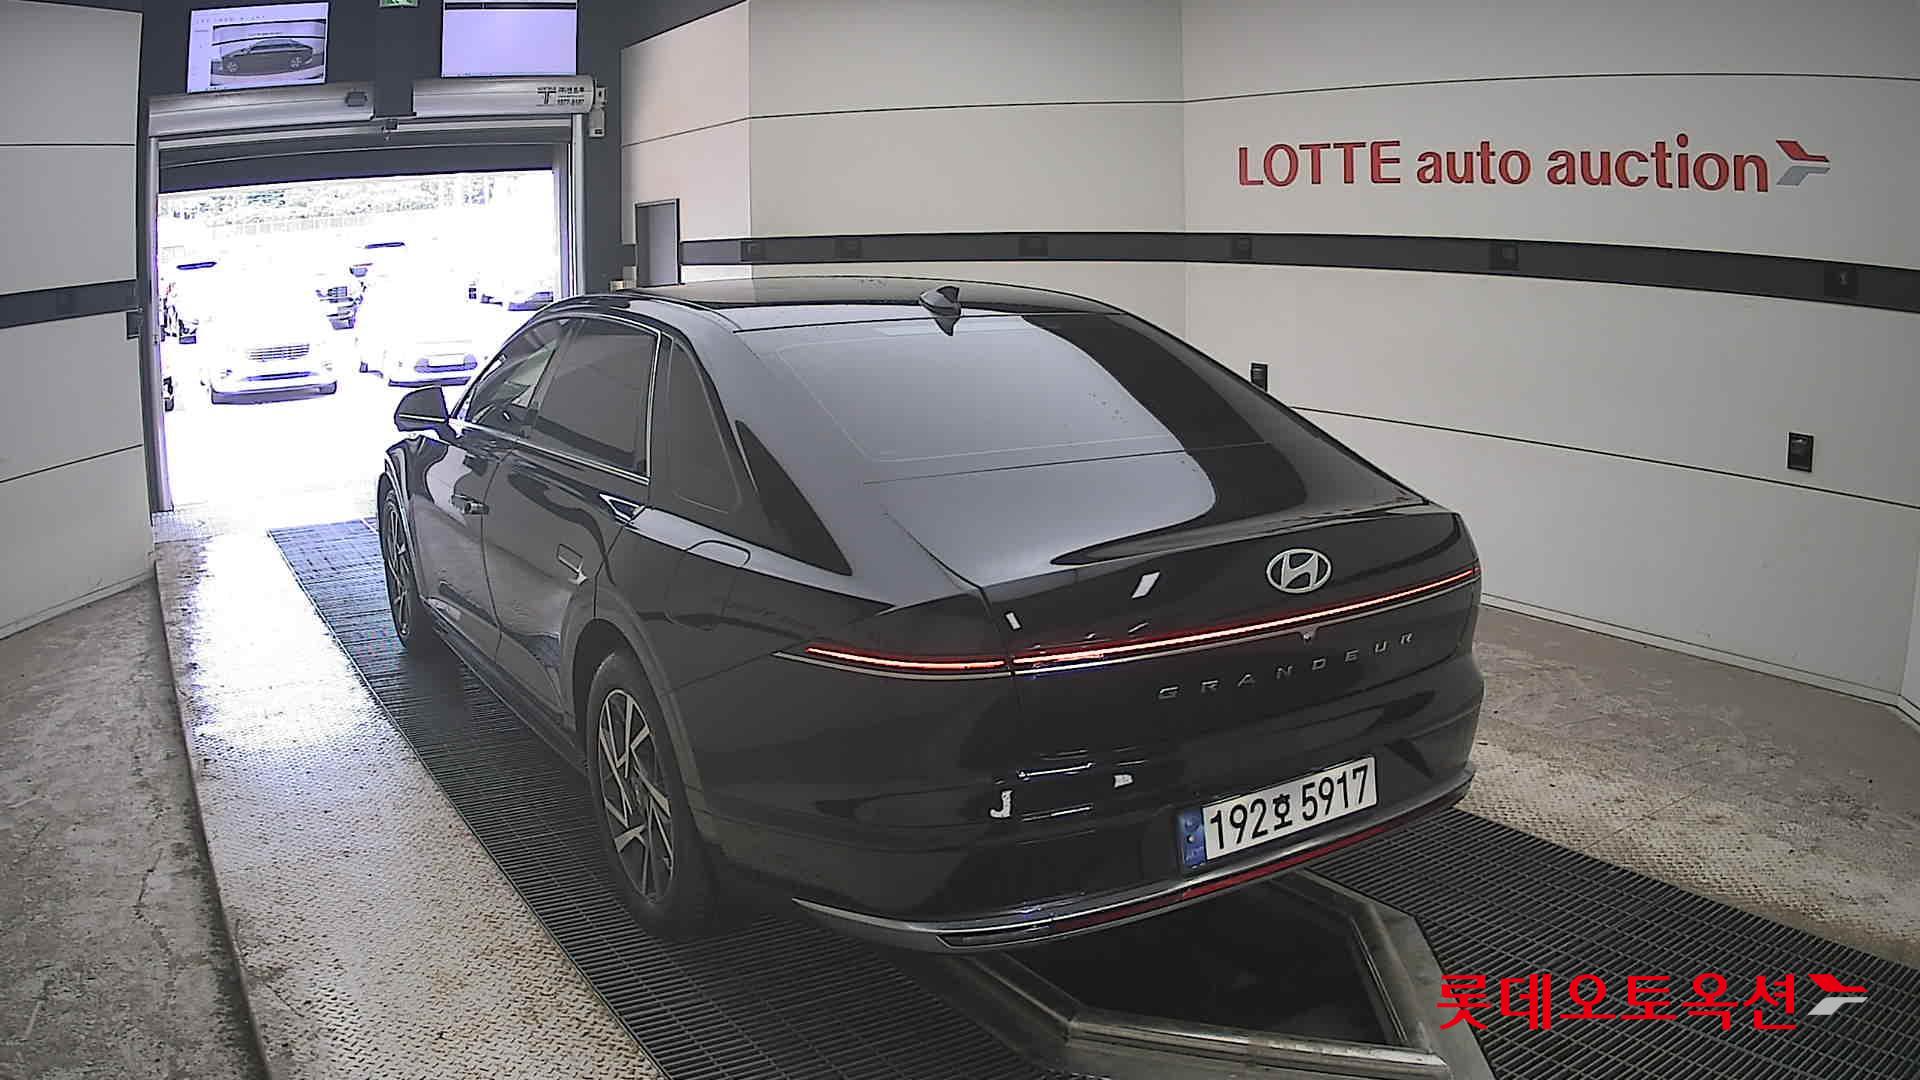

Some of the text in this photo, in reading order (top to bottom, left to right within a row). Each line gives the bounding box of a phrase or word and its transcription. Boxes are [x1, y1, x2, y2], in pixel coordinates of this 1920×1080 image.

[1239, 134, 1769, 193] LOTTE auto auction
[1158, 632, 1413, 699] GRANDEUR
[1301, 765, 1369, 821] 5917
